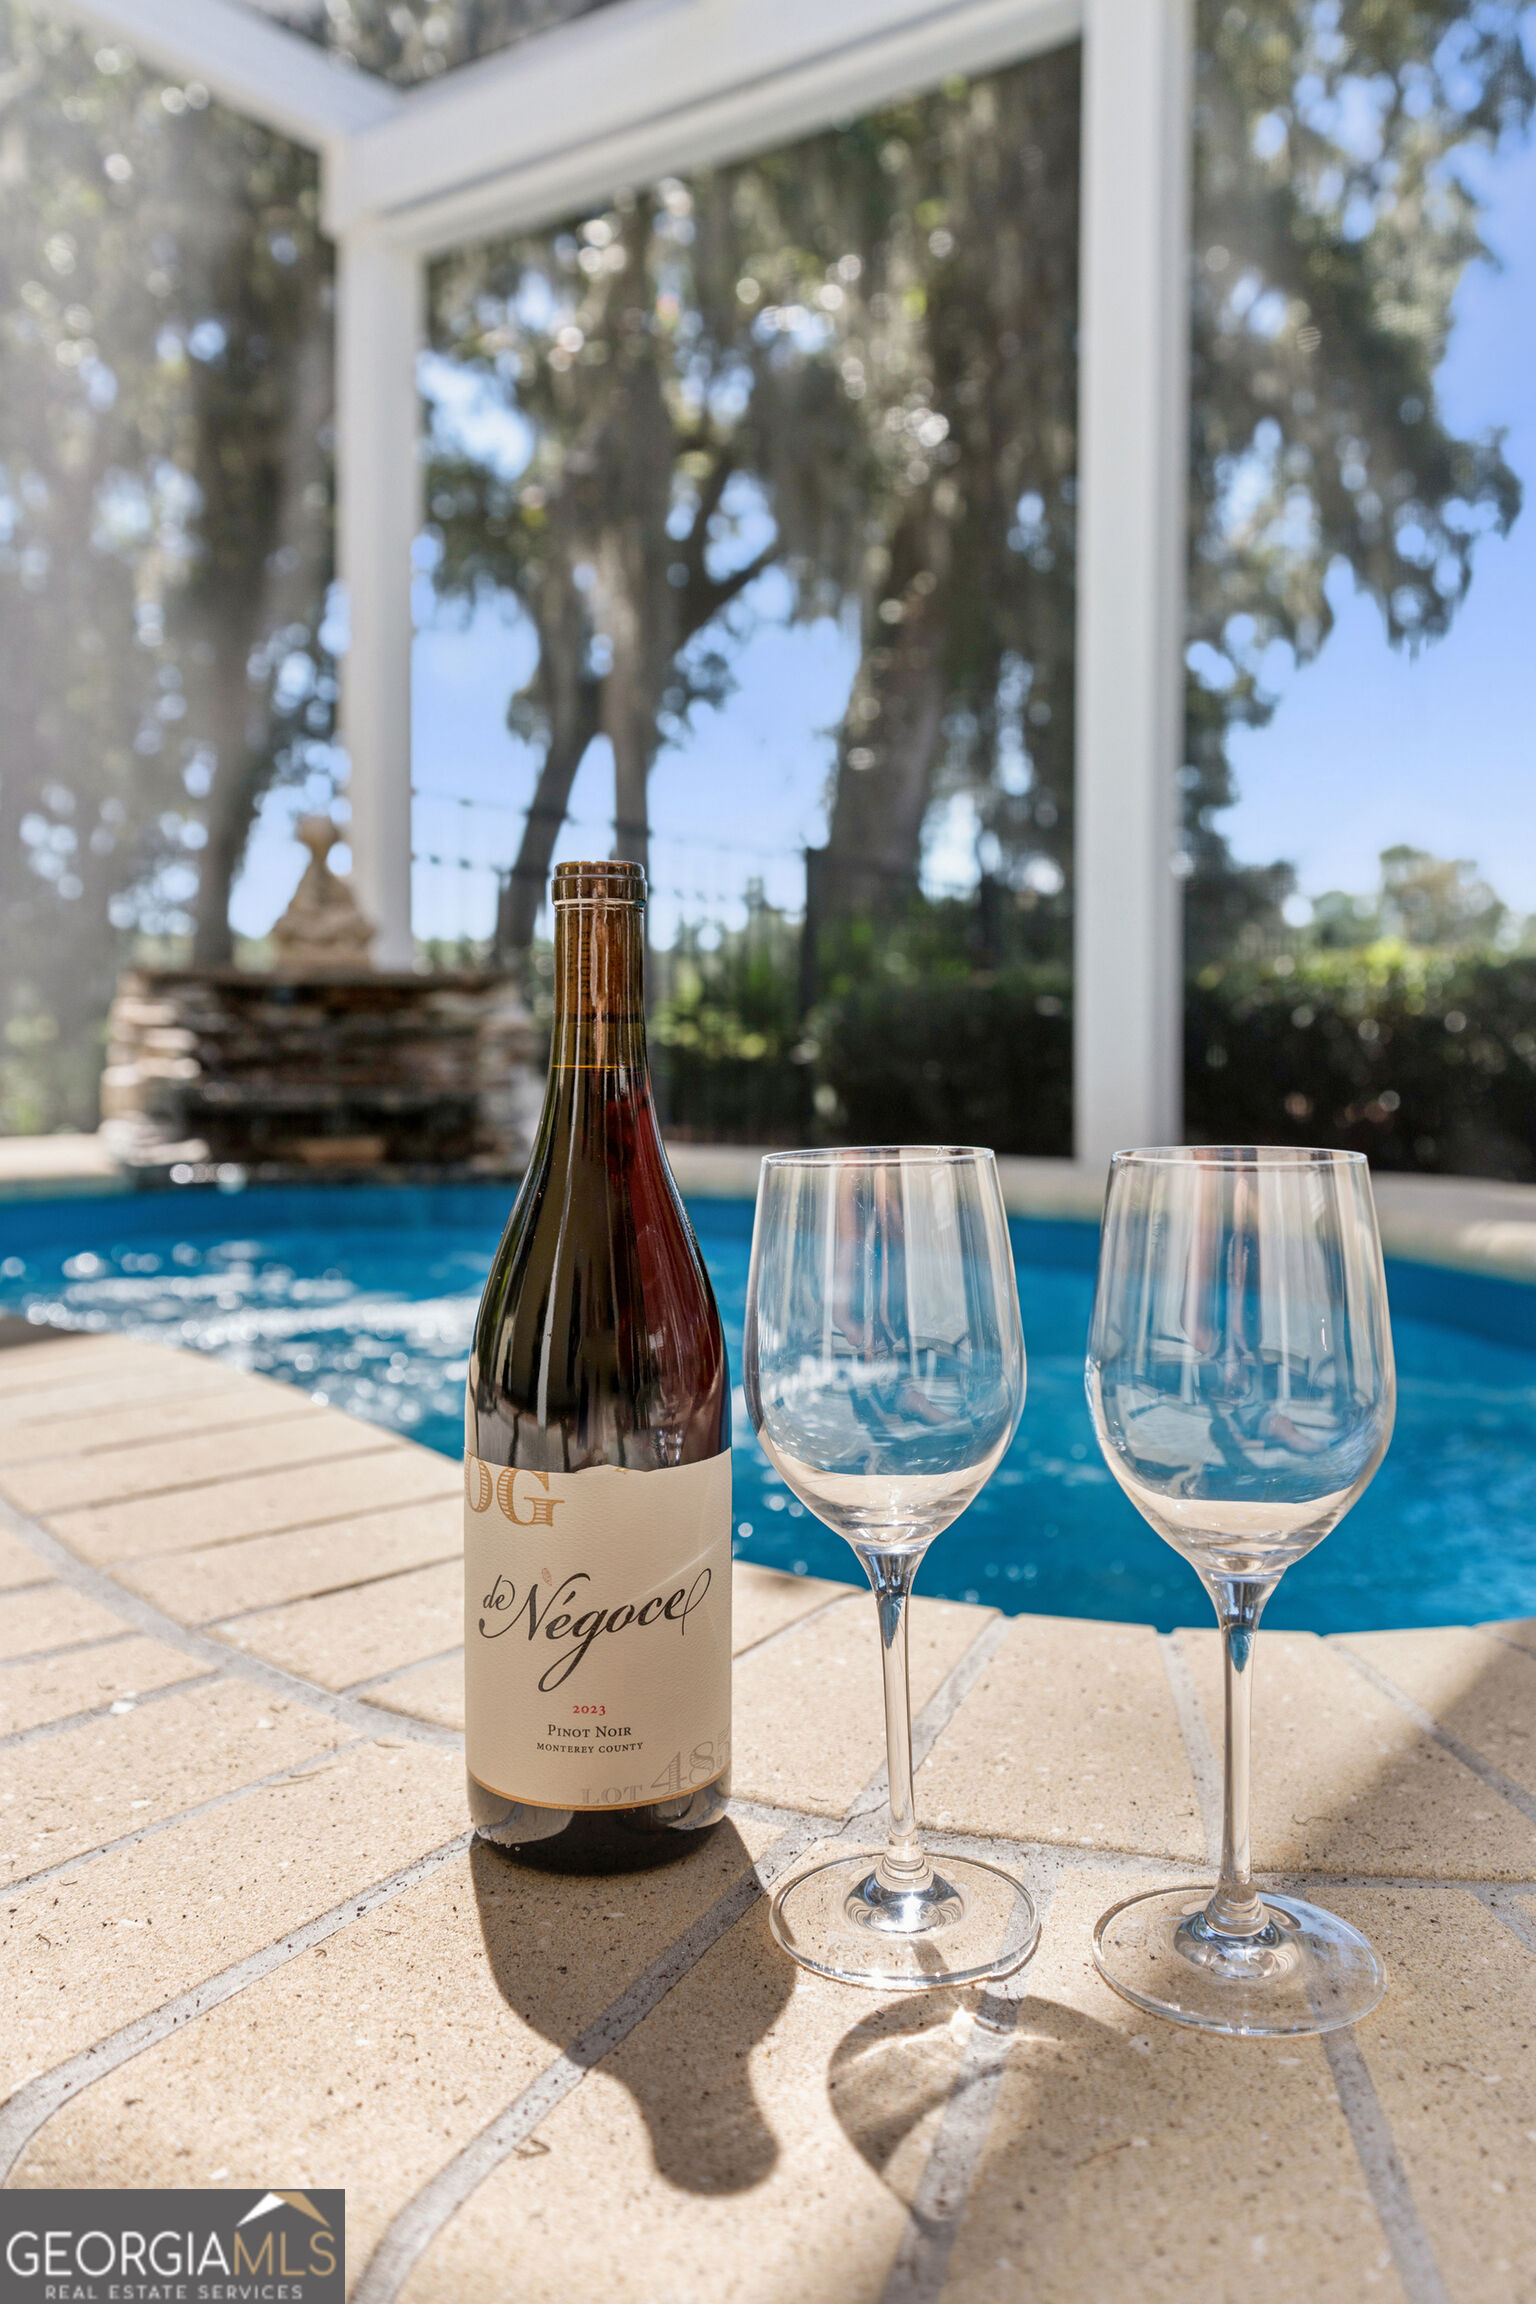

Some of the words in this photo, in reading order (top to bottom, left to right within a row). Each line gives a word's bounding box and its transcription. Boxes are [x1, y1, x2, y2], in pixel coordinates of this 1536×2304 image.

[482, 1574, 515, 1611] de
[478, 1568, 712, 1693] Négoce
[572, 1705, 606, 1716] 2023
[547, 1724, 591, 1738] PINOT
[595, 1725, 632, 1738] NOIR
[536, 1742, 594, 1753] MONTEREY
[598, 1741, 643, 1753] COUNTY
[581, 1784, 643, 1804] LOT
